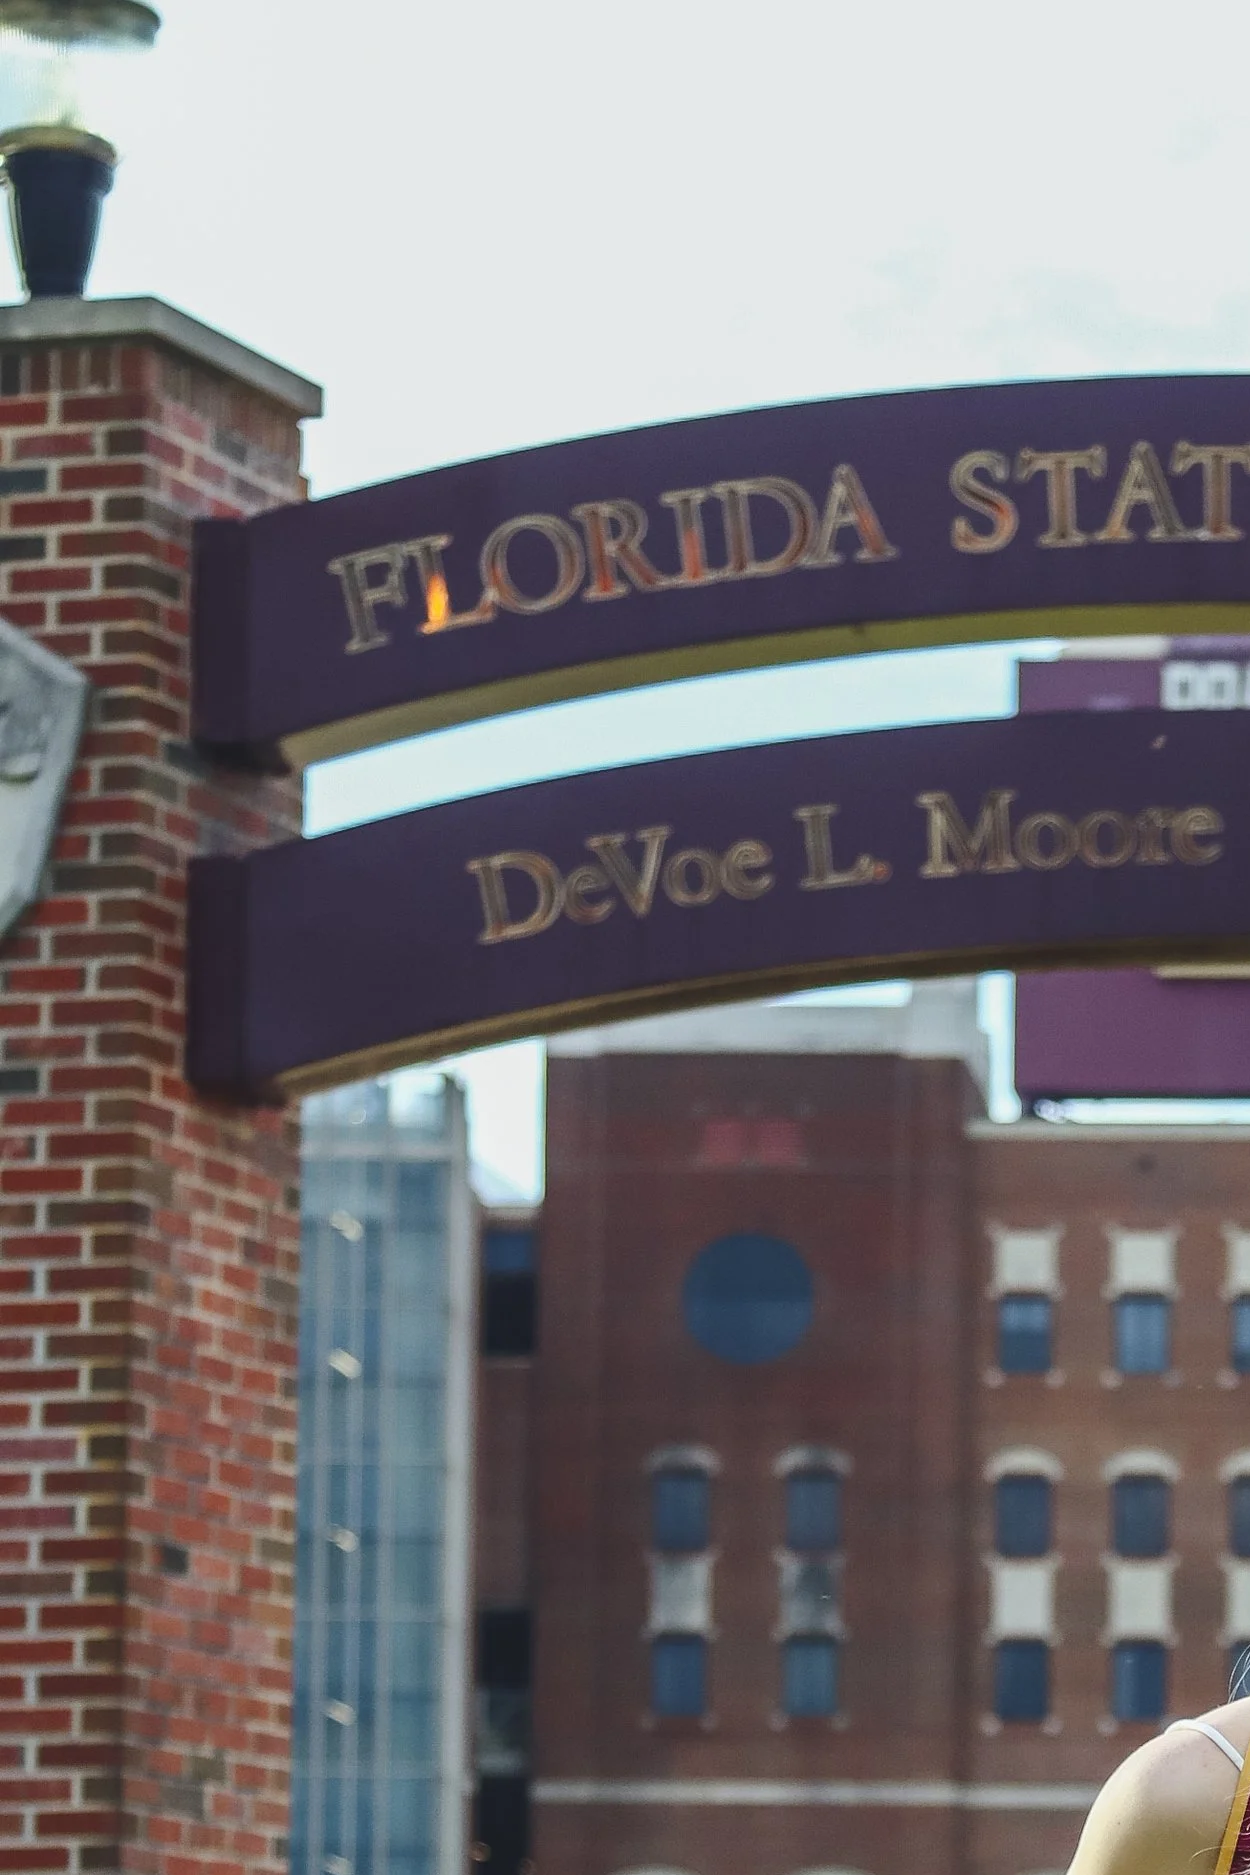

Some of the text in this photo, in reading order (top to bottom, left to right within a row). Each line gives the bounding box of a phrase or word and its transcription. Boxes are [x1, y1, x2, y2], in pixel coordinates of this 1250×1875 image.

[327, 463, 896, 656] FLORIDA
[466, 825, 774, 945] DeVoe
[795, 804, 892, 892] L.
[916, 790, 1226, 879] Moore
